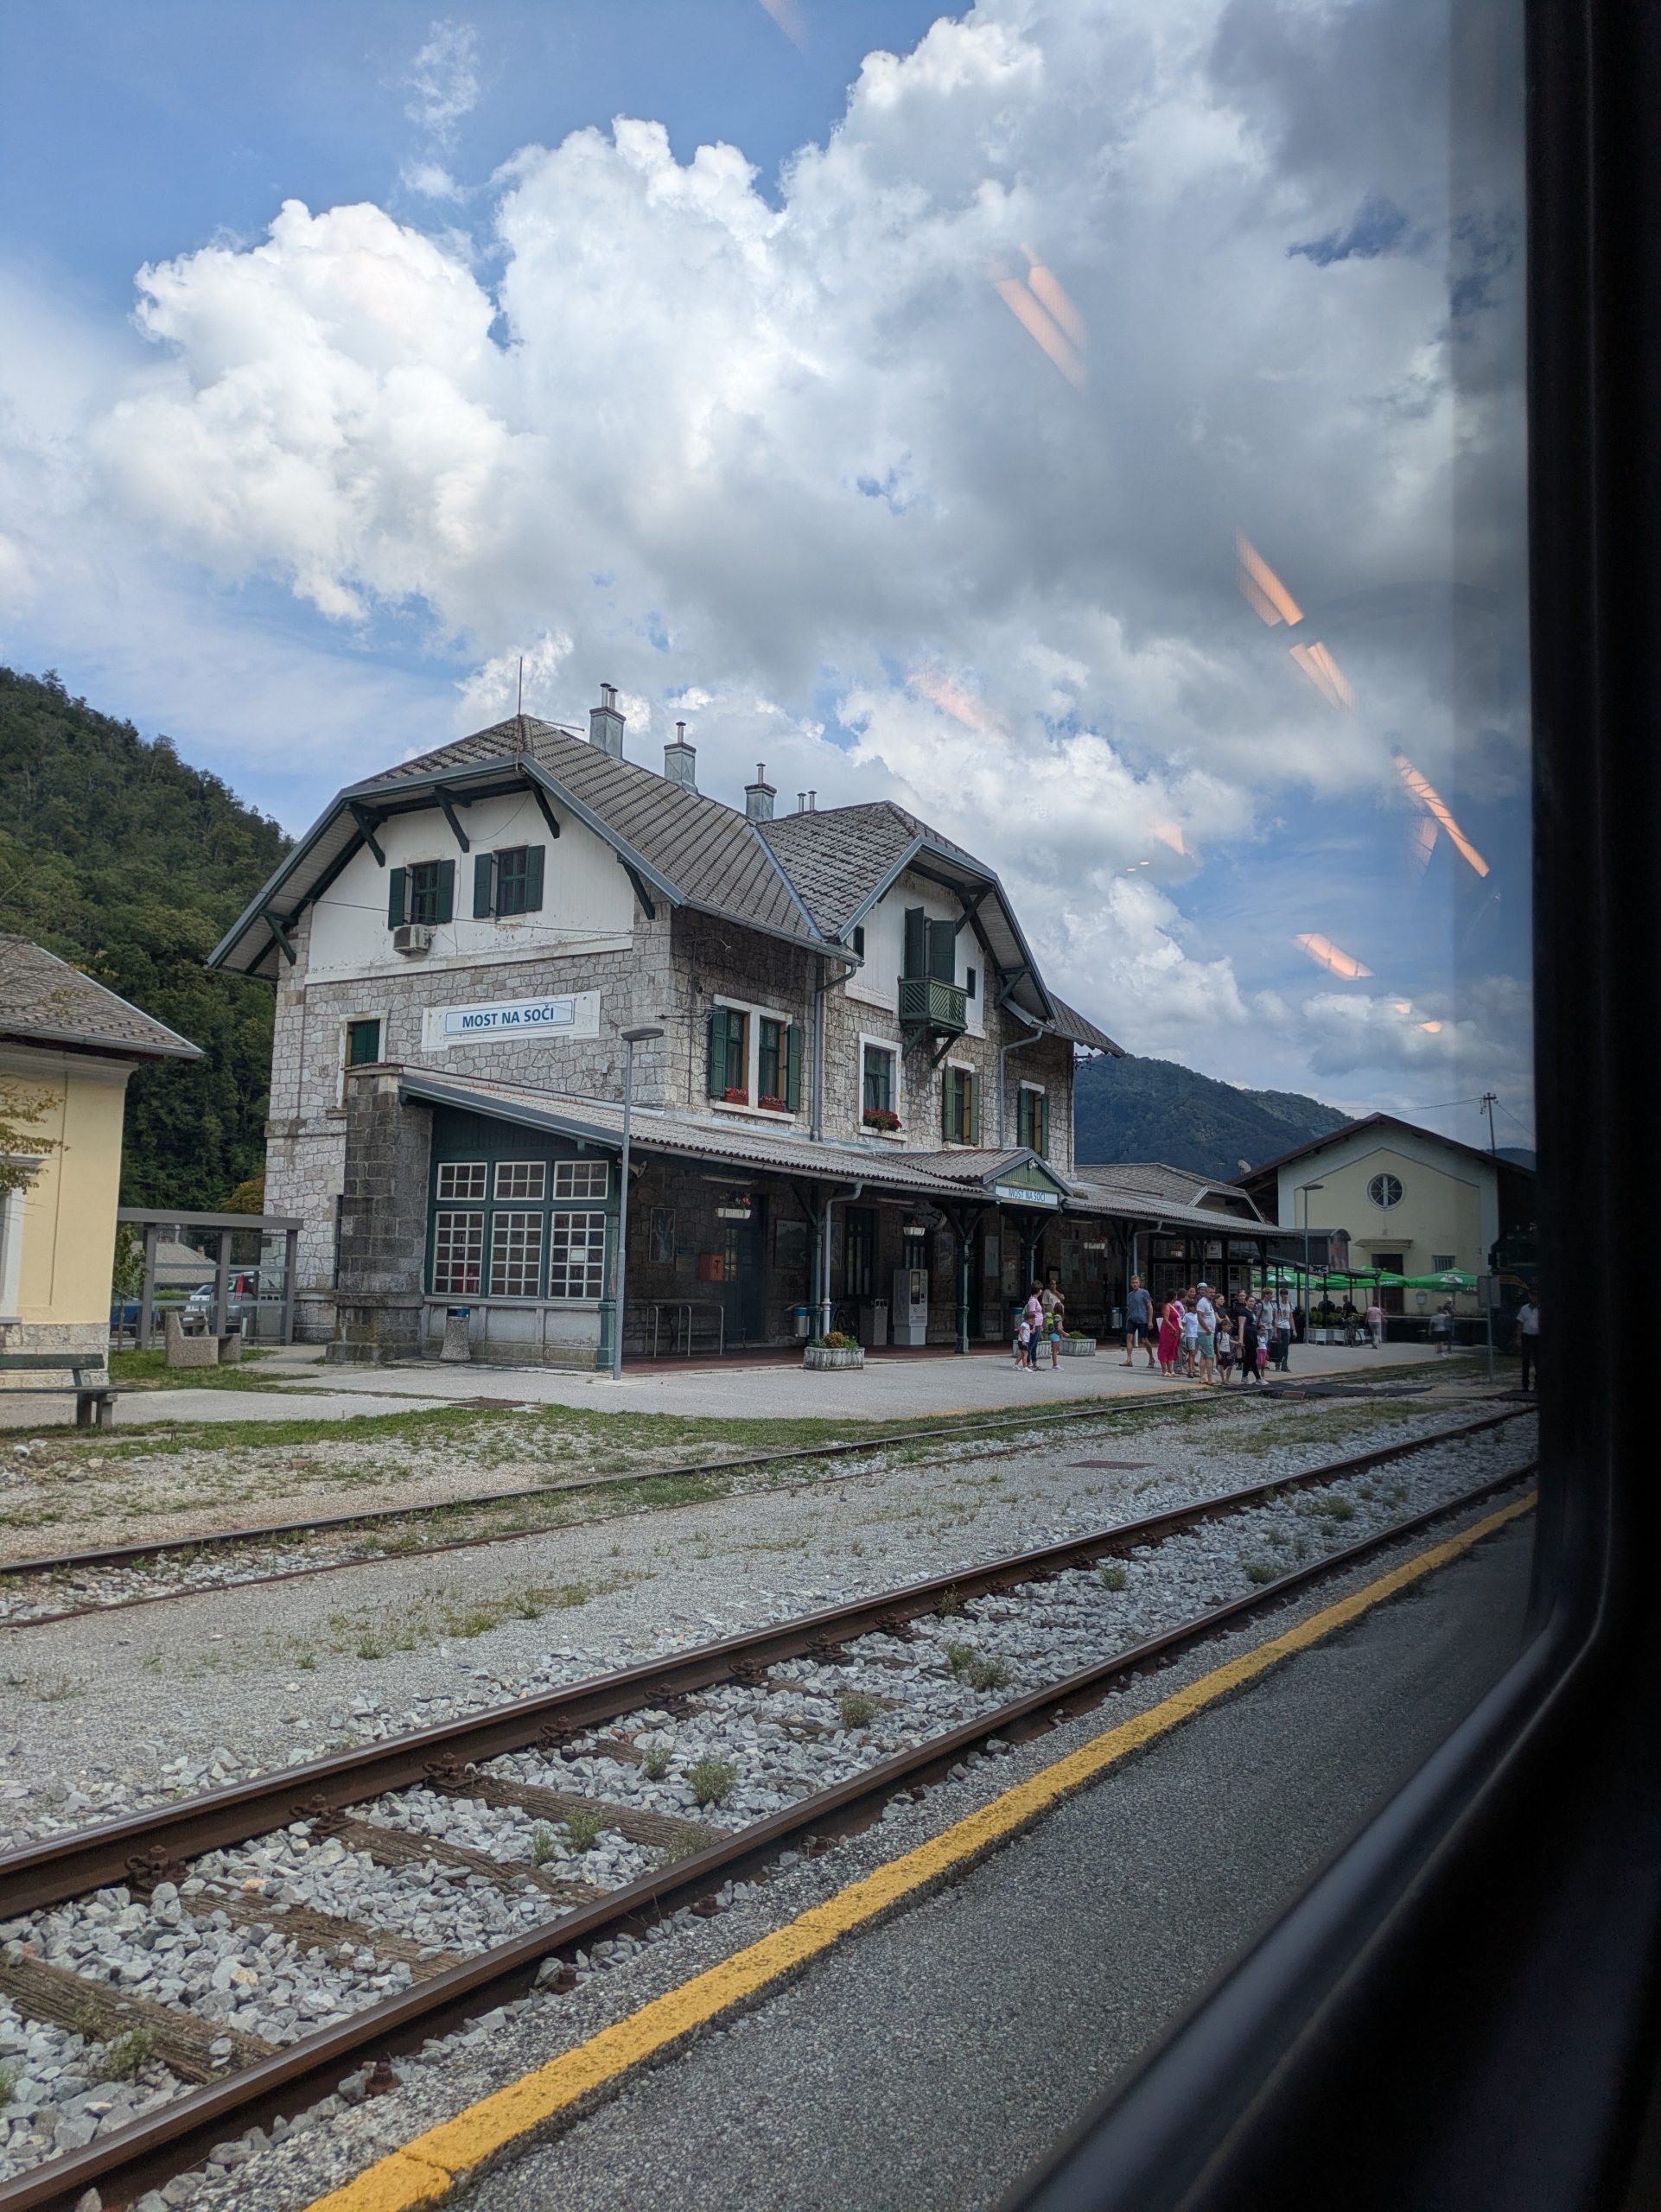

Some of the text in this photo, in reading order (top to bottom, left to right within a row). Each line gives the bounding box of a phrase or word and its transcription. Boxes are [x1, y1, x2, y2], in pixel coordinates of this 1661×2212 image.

[462, 1004, 554, 1027] MOST NA SOČI
[1009, 1188, 1024, 1198] MOST
[1025, 1191, 1034, 1200] NA
